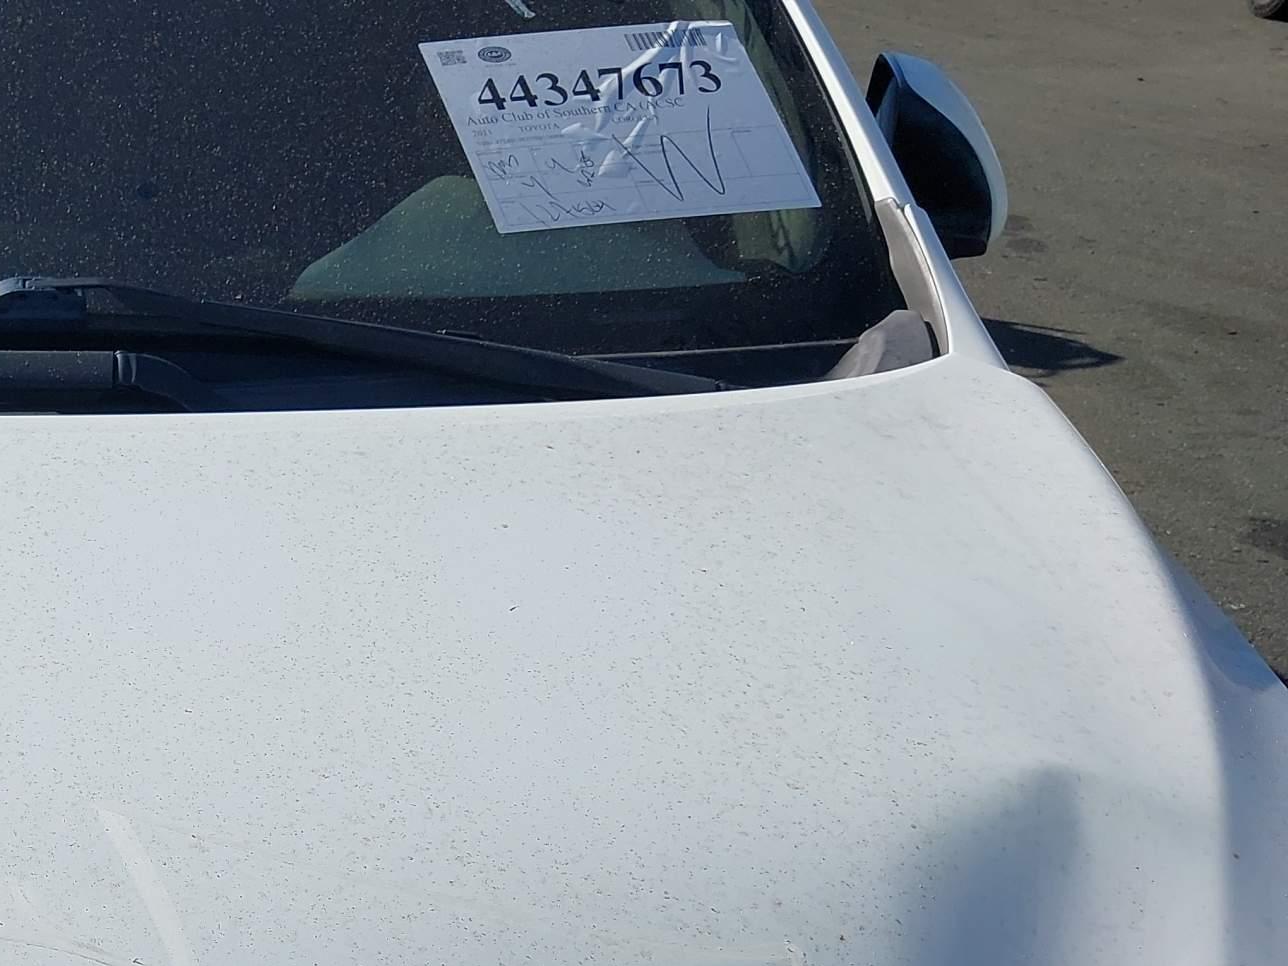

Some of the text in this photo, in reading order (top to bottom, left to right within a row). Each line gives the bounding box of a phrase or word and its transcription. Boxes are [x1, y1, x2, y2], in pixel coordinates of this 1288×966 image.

[477, 59, 722, 110] 44347673
[466, 115, 499, 127] Auto
[502, 109, 535, 123] Club
[536, 108, 552, 120] of
[554, 103, 611, 118] Southern
[613, 101, 638, 113] CA
[518, 123, 560, 133] TOYOTA
